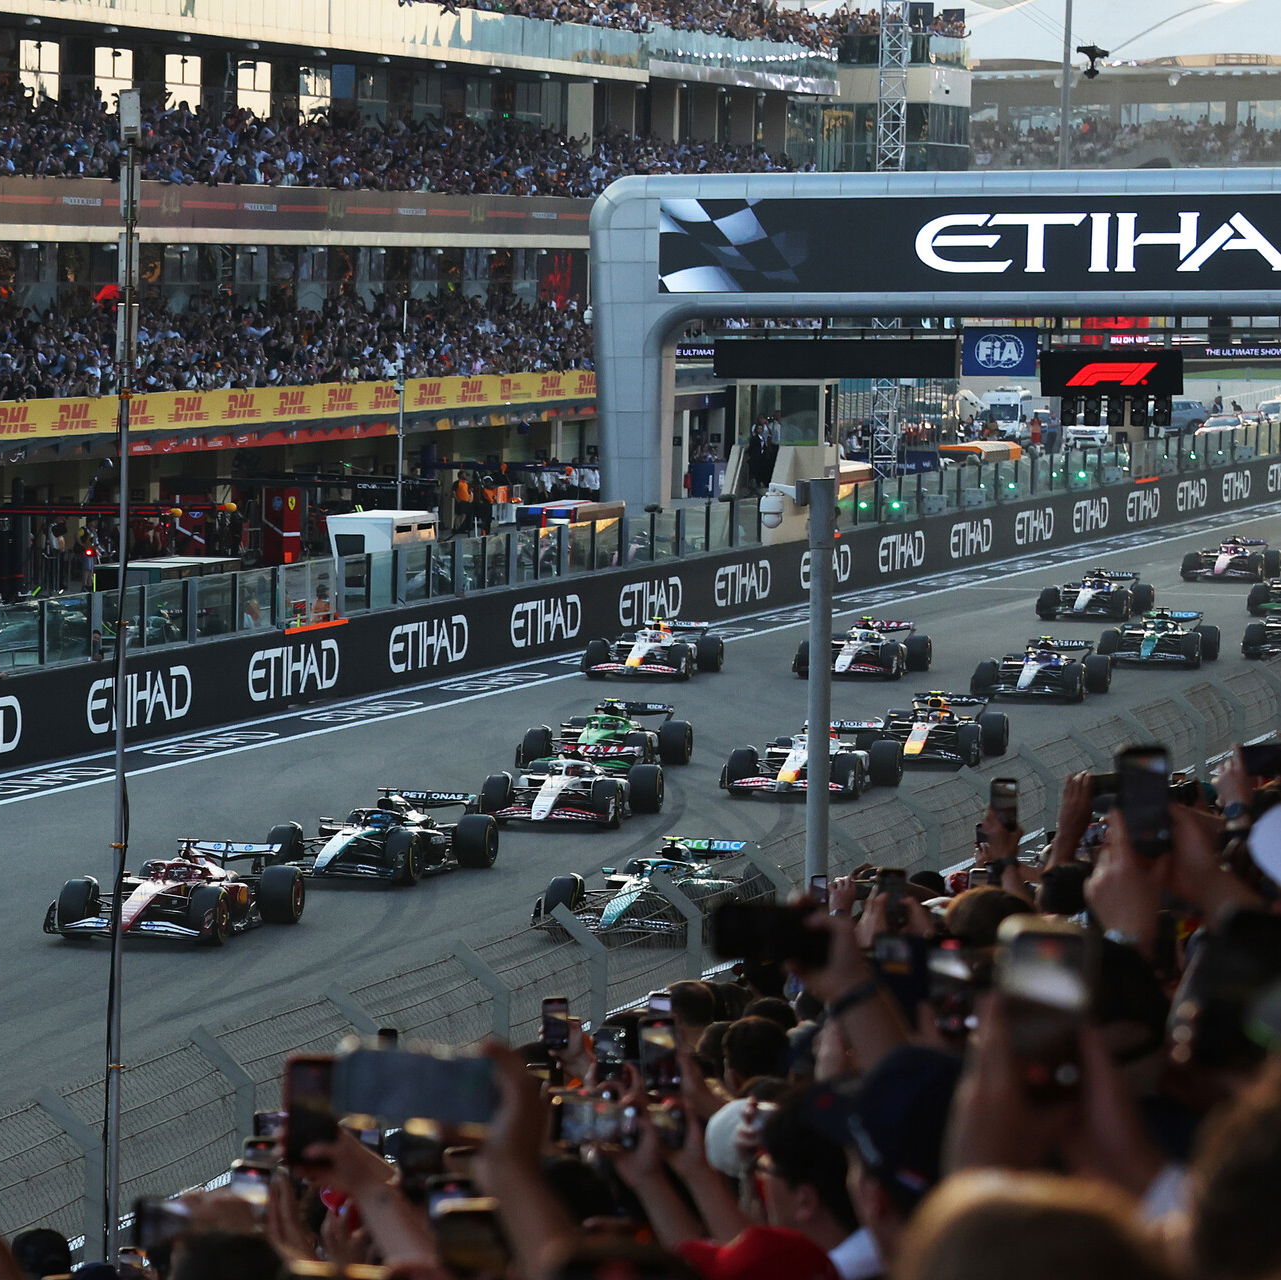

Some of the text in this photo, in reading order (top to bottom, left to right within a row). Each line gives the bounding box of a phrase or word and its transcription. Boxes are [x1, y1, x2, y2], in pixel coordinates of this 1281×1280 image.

[914, 211, 1281, 274] ETIHA
[682, 348, 714, 356] ULTIMAT
[1205, 348, 1221, 356] THE
[1222, 348, 1260, 356] ULTIMATE
[59, 403, 92, 430] DHL
[170, 396, 203, 423] DHL
[224, 393, 256, 419] DHL
[278, 391, 306, 416] DHL
[326, 388, 354, 412] DHL
[1176, 478, 1208, 512] ETIHAD
[1222, 470, 1251, 503] ETIHAD
[1073, 496, 1109, 533] ETIHAD
[1126, 487, 1160, 522] ETIHAD
[950, 518, 992, 559] ETIHAD
[1015, 507, 1054, 545] ETIHAD
[800, 544, 851, 590] EAD
[878, 530, 925, 573] ETIHAD
[715, 560, 771, 607] ETIHAD
[619, 576, 682, 627] ETIHAD
[510, 594, 581, 648] ETIHAD
[389, 614, 469, 673] ETIHAD
[248, 638, 340, 701] ETIHAD
[831, 720, 863, 728] UDOR
[681, 839, 747, 849] aramc
